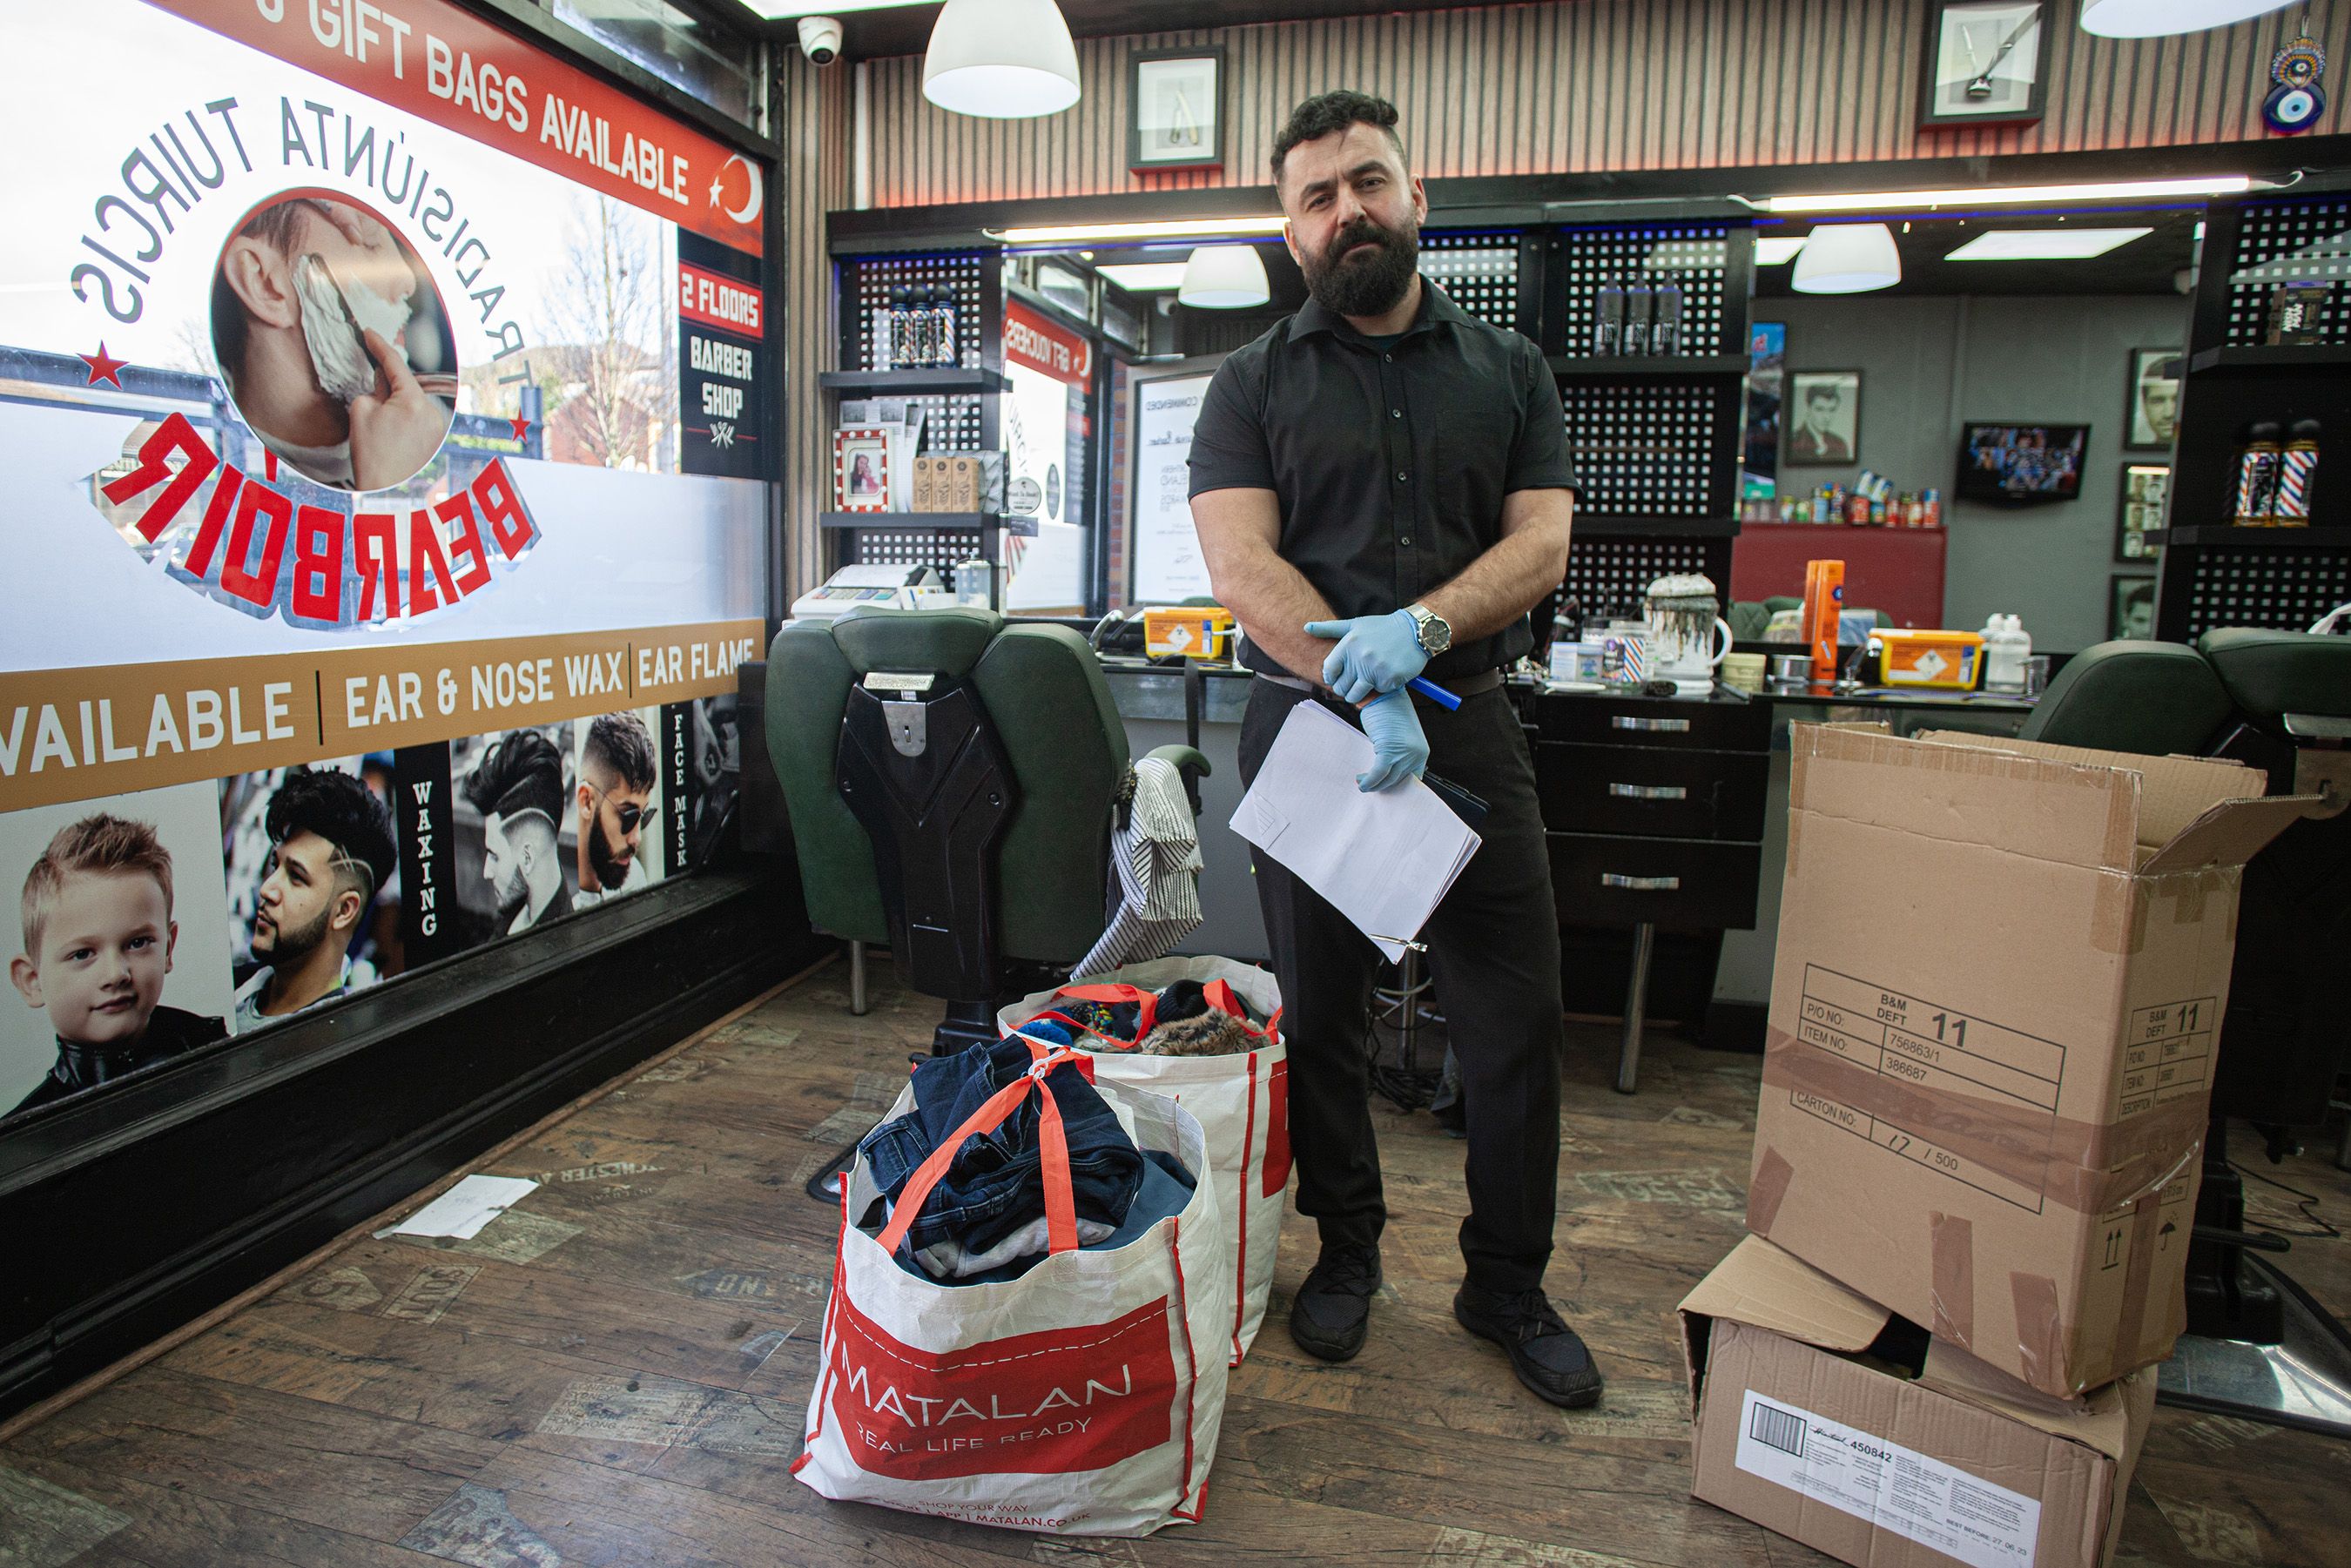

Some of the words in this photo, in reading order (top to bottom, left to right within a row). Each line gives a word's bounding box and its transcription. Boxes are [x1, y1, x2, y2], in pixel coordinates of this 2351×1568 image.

[308, 0, 411, 79] GIFT
[426, 33, 529, 132] BAGS
[539, 93, 690, 206] AVAILABLE
[681, 273, 694, 309] 2
[698, 278, 758, 328] FLOORS
[690, 334, 753, 381] BARBER
[702, 381, 744, 420] SHOP
[638, 645, 684, 688] EAR
[690, 638, 754, 680] FLAME
[346, 671, 423, 728] EAR
[436, 668, 458, 716] &
[471, 658, 554, 711] NOSE
[564, 651, 623, 697] WAX
[674, 714, 684, 786] FACE
[674, 796, 687, 867] MASK
[413, 781, 437, 937] WAXING
[1826, 1010, 1845, 1027] NO:
[1876, 1006, 1908, 1026] DEFT
[1880, 993, 1908, 1012] B&M
[2149, 1010, 2167, 1023] B&M
[2178, 1003, 2199, 1032] 11
[1803, 1025, 1829, 1045] ITEM
[1829, 1034, 1848, 1053] NO:
[1931, 1012, 1967, 1047] 11
[2146, 1024, 2166, 1038] DEFT
[1890, 1033, 1941, 1063] 756863/1
[1885, 1056, 1927, 1082] 386687
[1796, 1091, 1838, 1120] CARTON
[1838, 1109, 1857, 1128] NO:
[1935, 1152, 1958, 1171] 500
[841, 1339, 1132, 1429] MATALAN
[926, 1437, 985, 1453] LIFE
[1000, 1417, 1093, 1444] READY
[1850, 1440, 1893, 1464] 450842
[918, 1499, 955, 1511] SHOP
[957, 1502, 994, 1513] YOUR
[995, 1503, 1030, 1514] WAY
[937, 1509, 961, 1519] APP
[975, 1510, 1091, 1528] MATALAN.CO.UK
